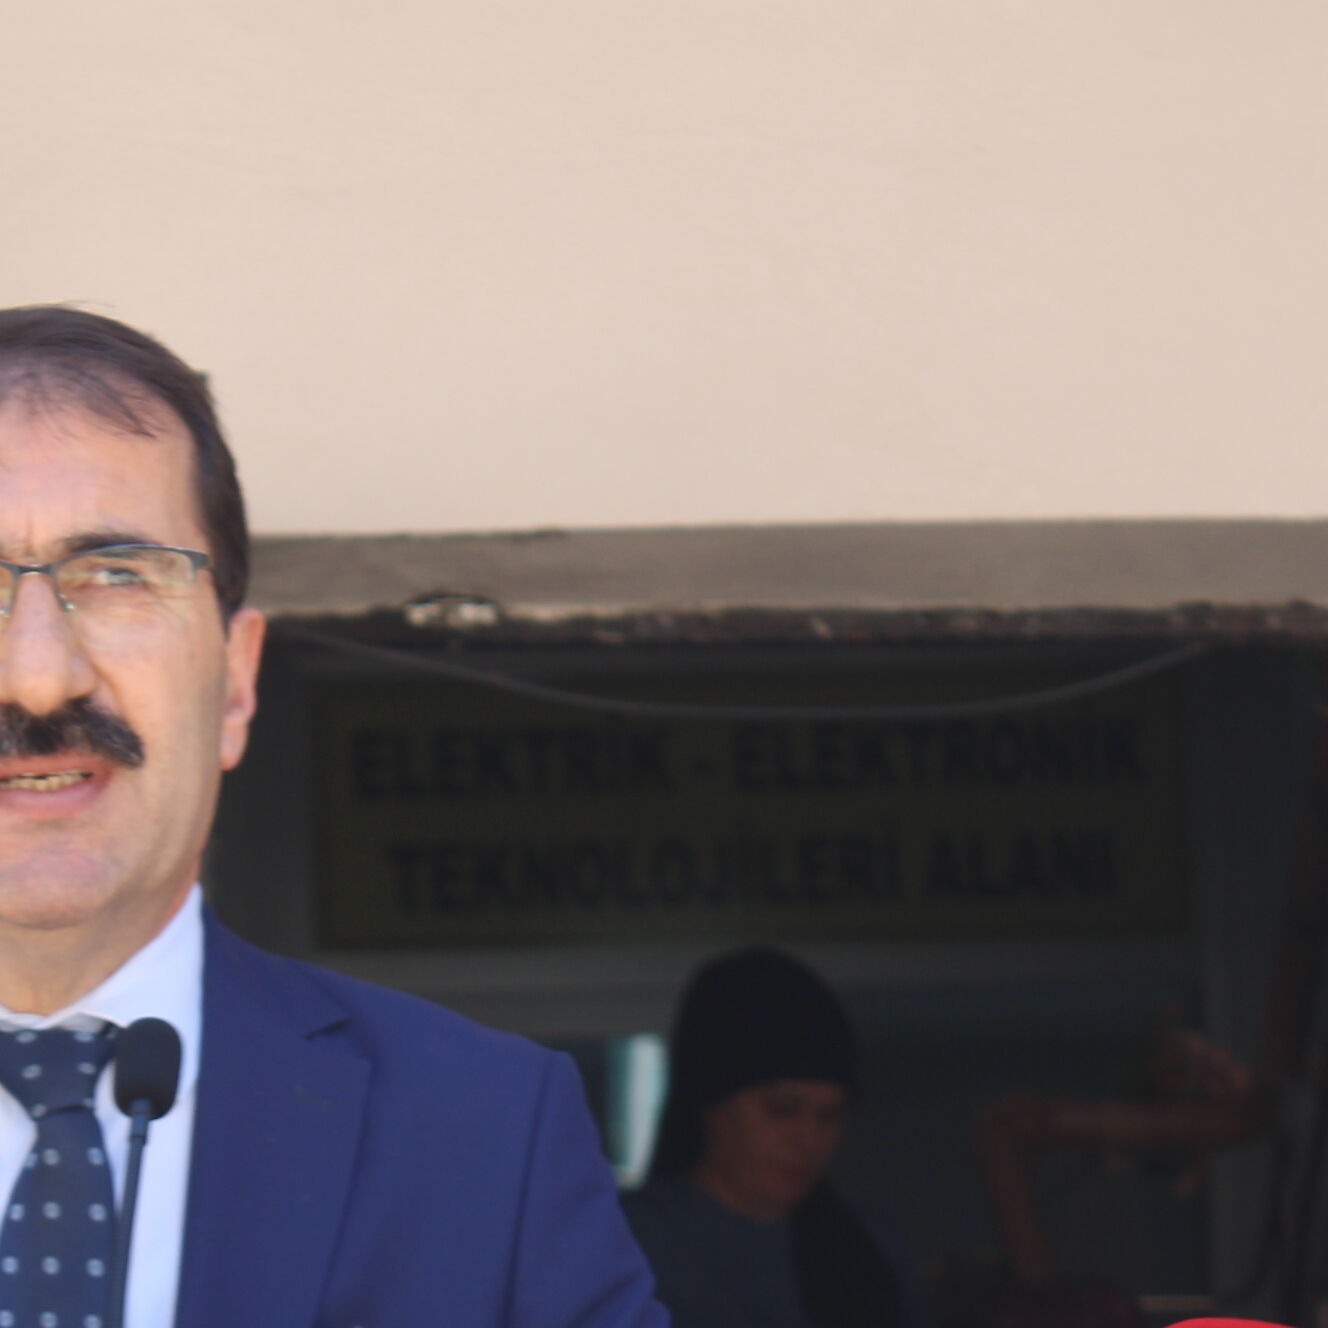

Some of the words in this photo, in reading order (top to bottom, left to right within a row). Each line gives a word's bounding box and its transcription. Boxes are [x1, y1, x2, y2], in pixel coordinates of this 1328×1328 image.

[351, 716, 675, 799] ELEKTRİK
[733, 706, 1147, 793] ELEKTRONİK
[386, 815, 902, 916] TEKNOLOJİLERİ
[922, 828, 1118, 902] ALANI
